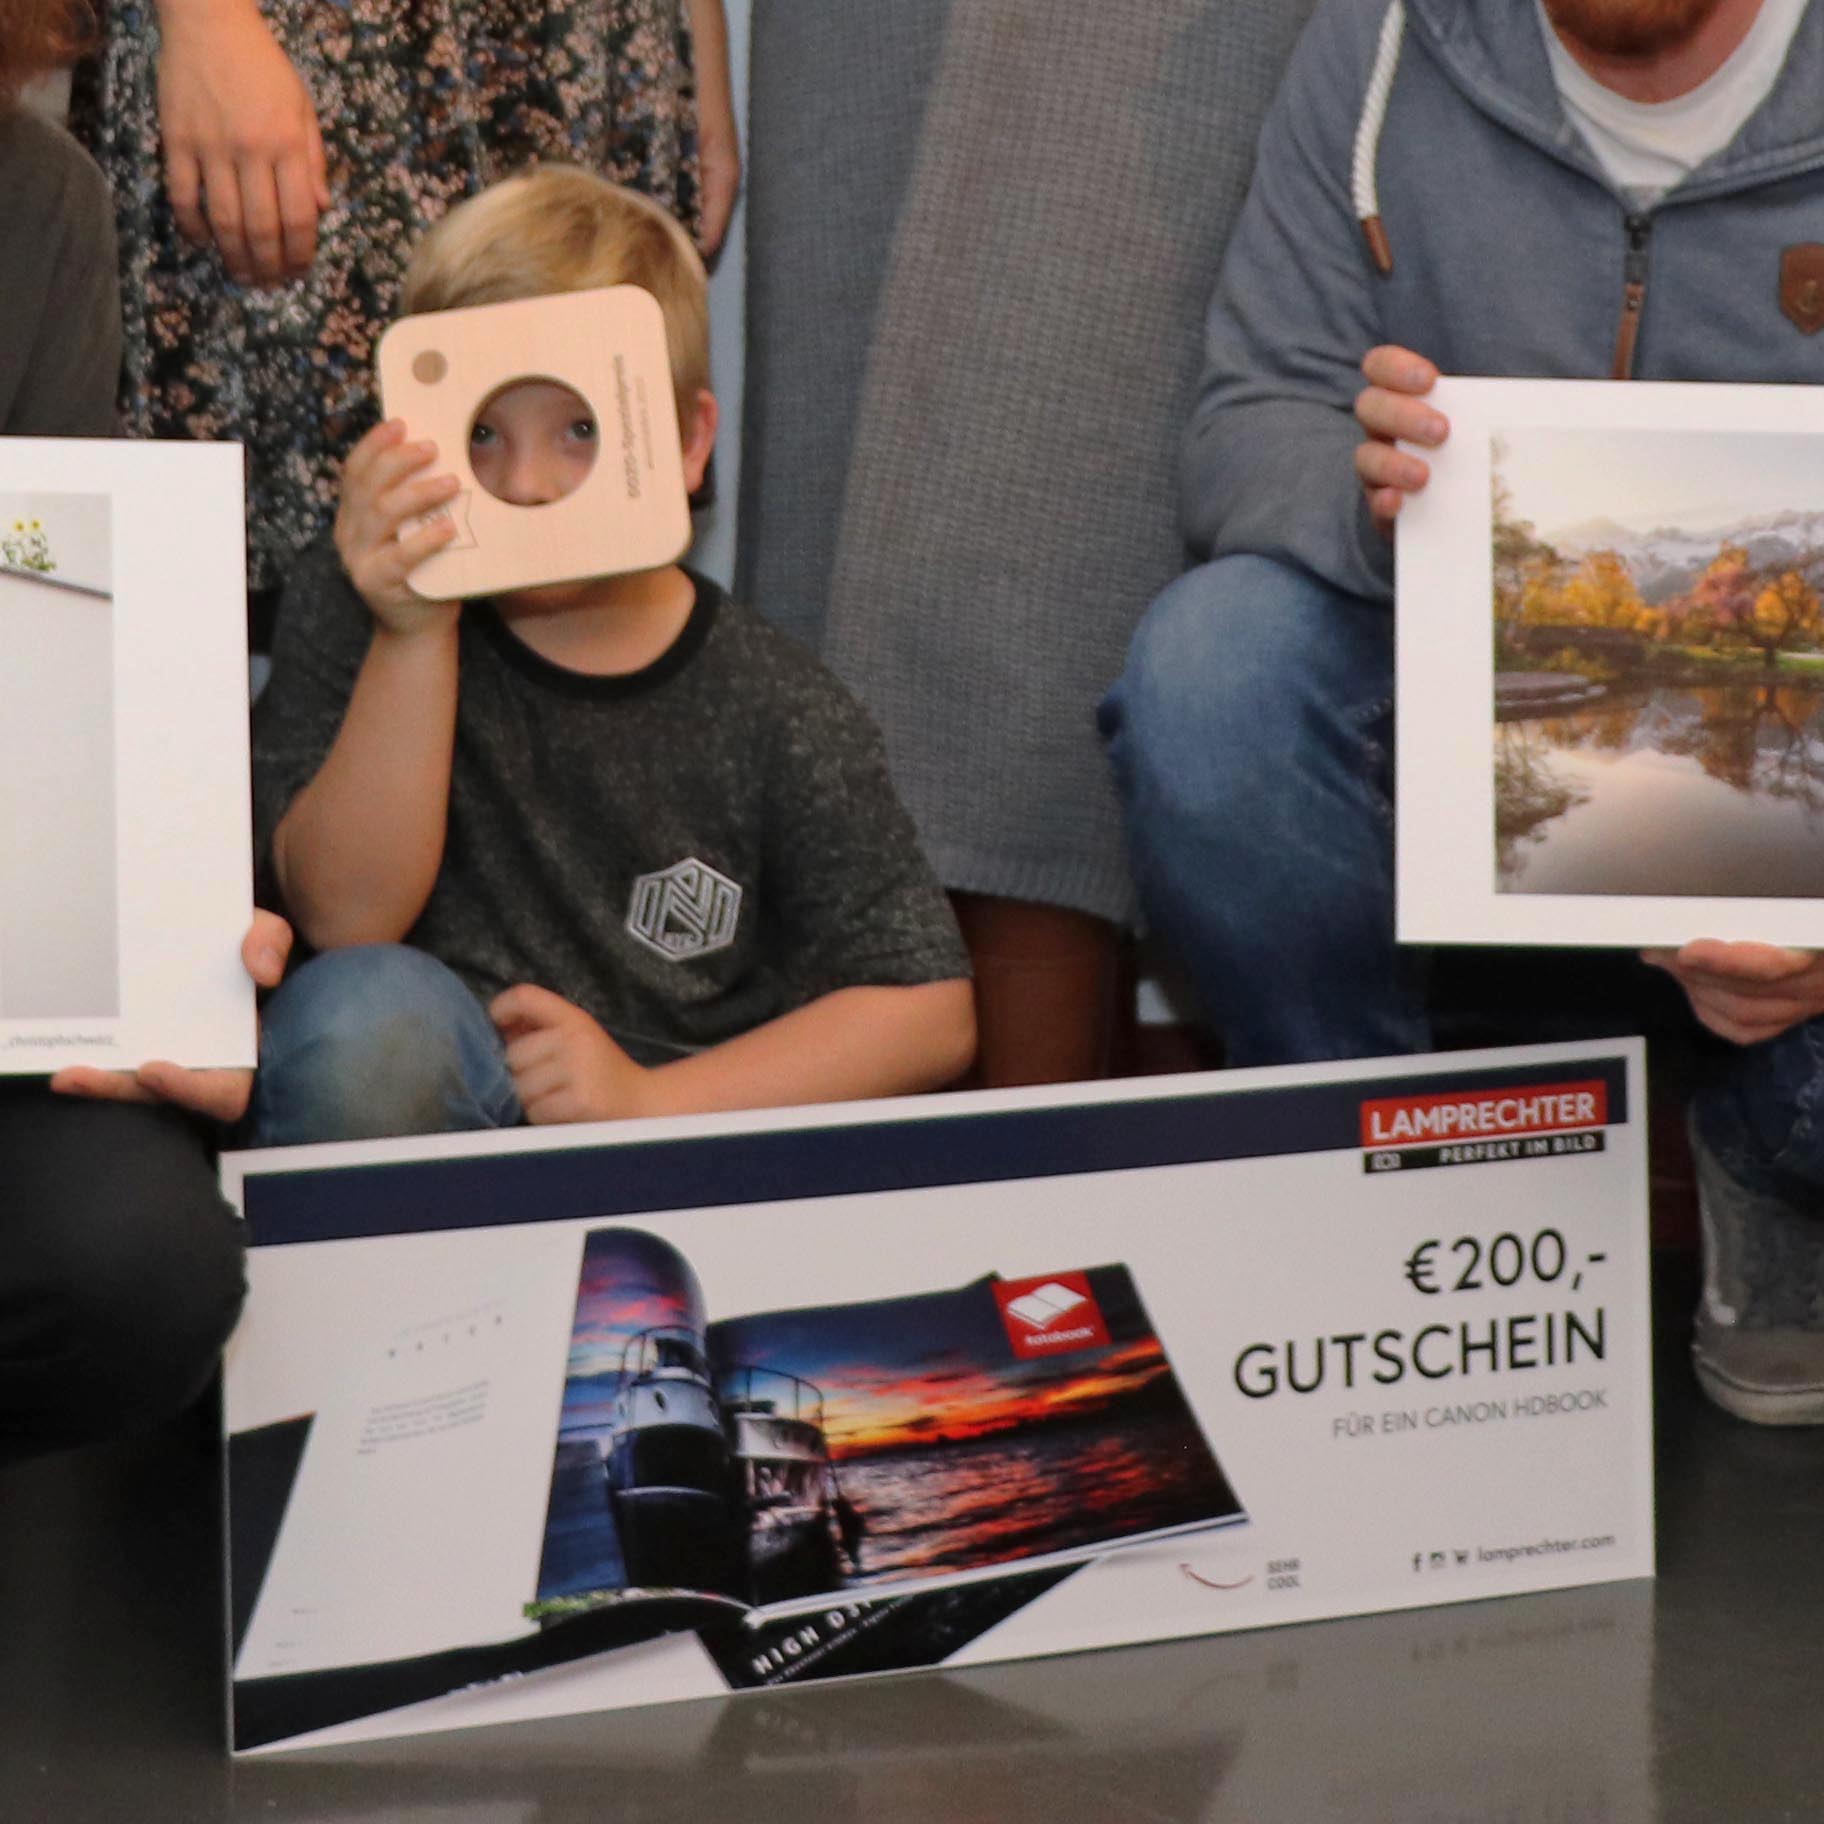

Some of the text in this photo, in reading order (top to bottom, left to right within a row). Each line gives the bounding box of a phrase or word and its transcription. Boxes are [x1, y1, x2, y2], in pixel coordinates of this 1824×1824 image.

[1370, 1092, 1596, 1141] LAMPRECHTER
[1439, 1134, 1596, 1164] PERFEKT IM BILD
[1405, 1228, 1607, 1295] €200,-
[1232, 1307, 1608, 1400] GUTSCHEIN
[1333, 1387, 1608, 1439] FÜR EIN CANON HDBOOK
[1478, 1534, 1616, 1565] lamprechter.com
[751, 1625, 820, 1676] HIGH
